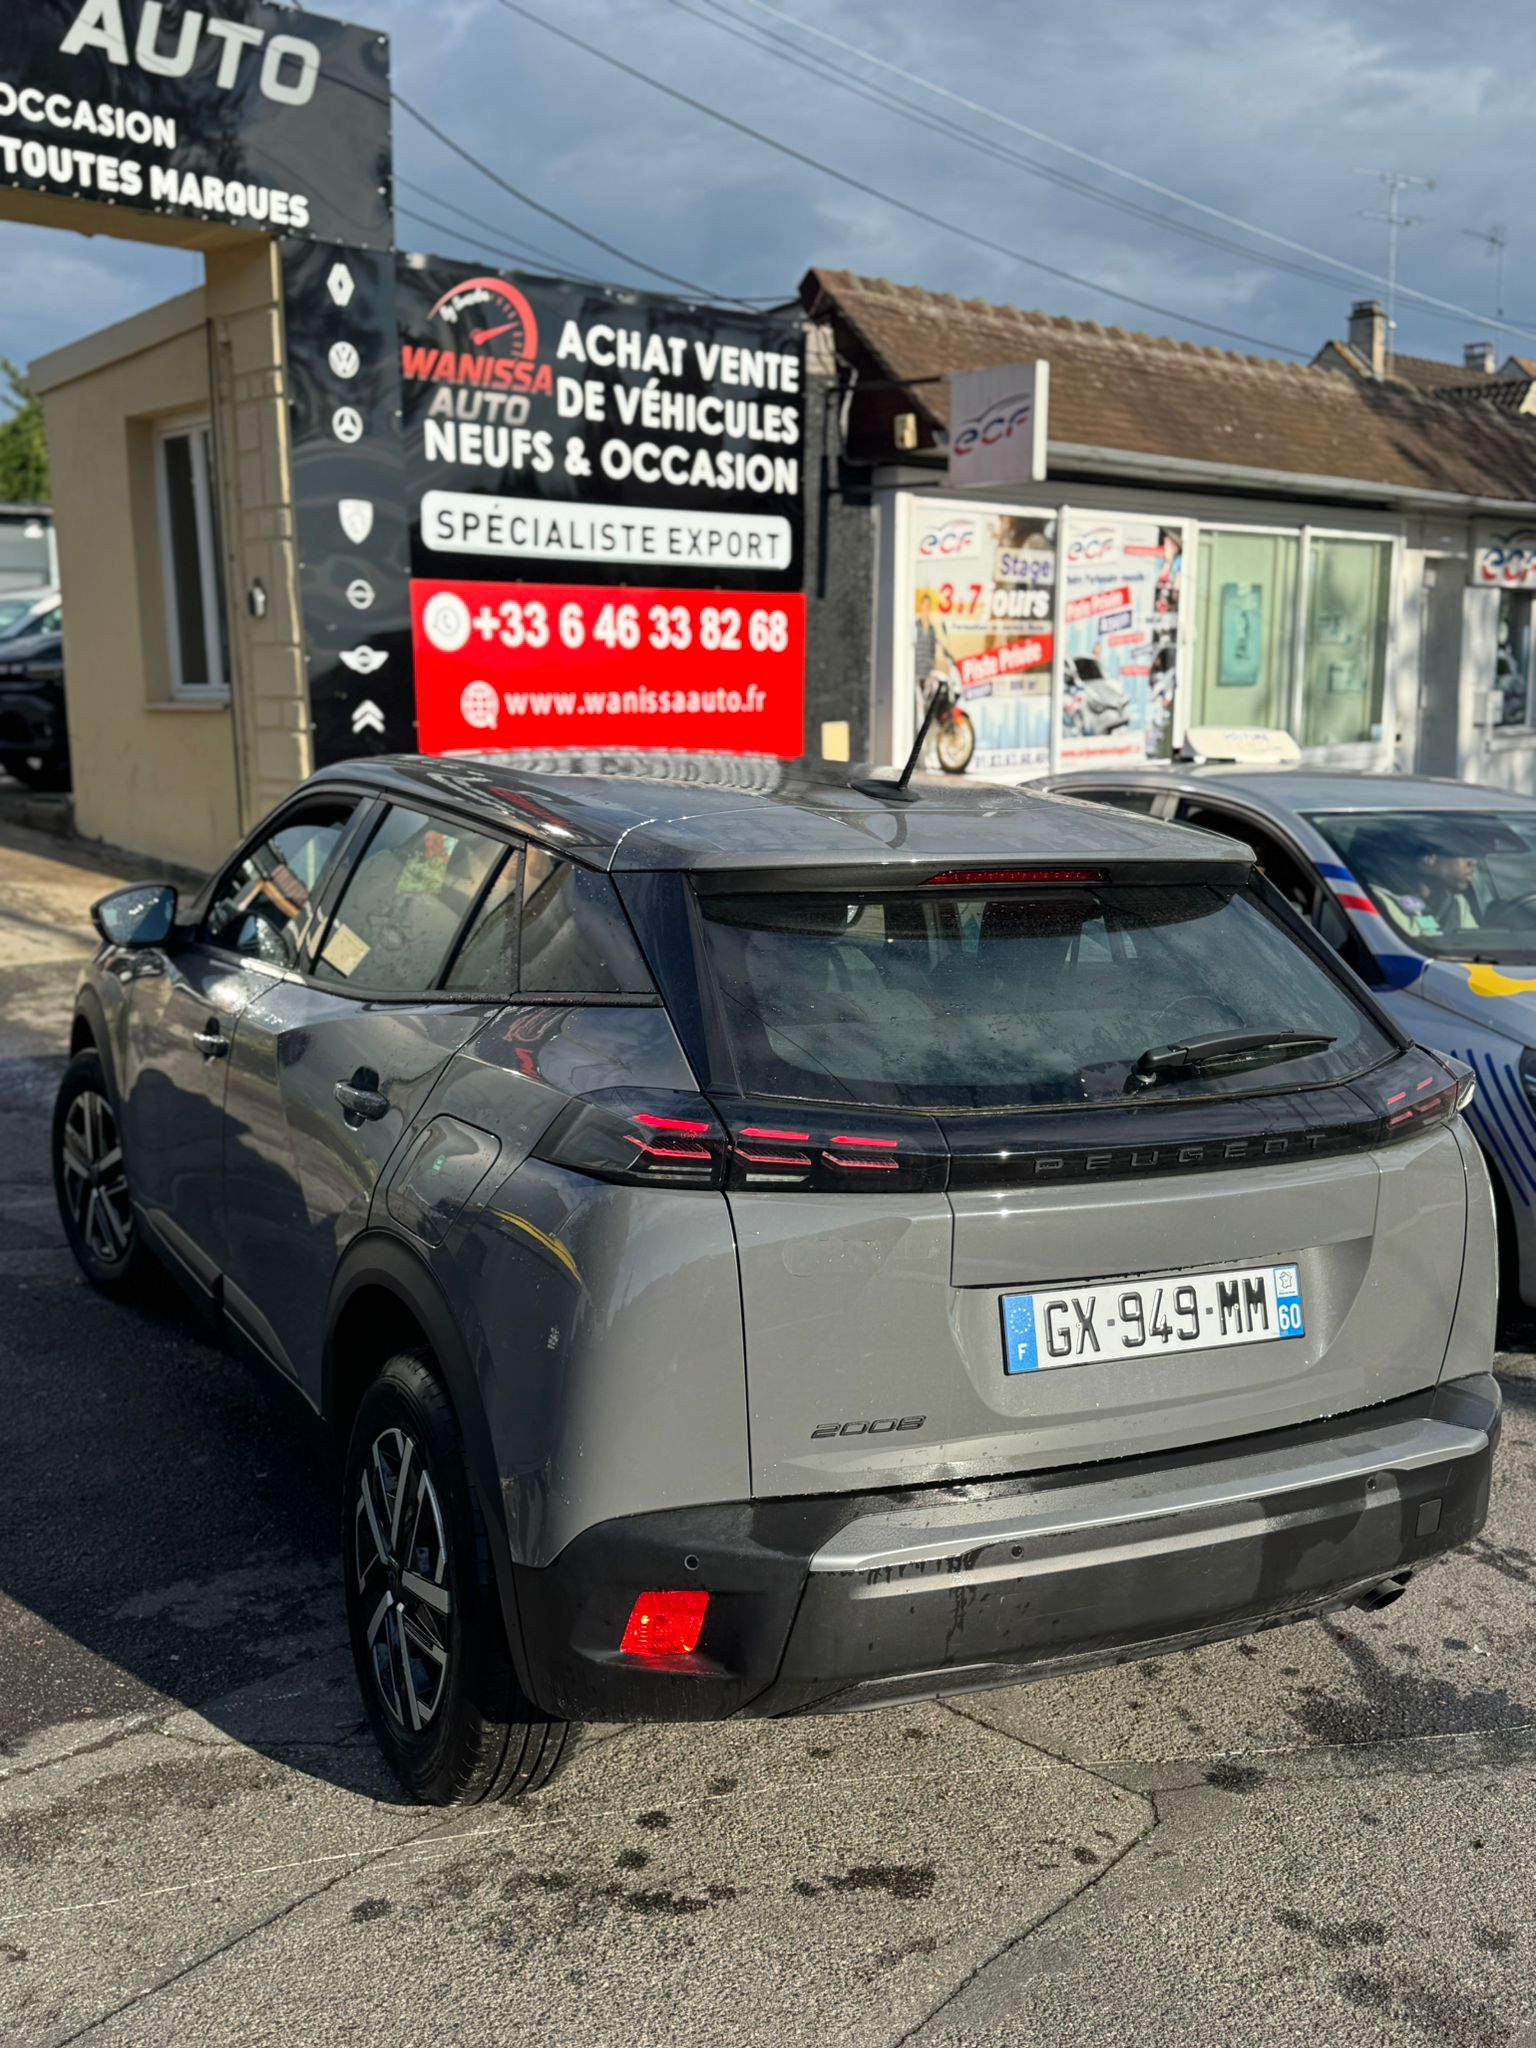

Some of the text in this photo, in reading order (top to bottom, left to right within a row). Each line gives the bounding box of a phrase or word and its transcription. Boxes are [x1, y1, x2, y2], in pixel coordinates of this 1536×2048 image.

[59, 0, 321, 106] AUTO
[0, 82, 176, 149] OCCASION
[0, 135, 309, 228] TOUTES MARQUES
[401, 345, 553, 395] WANISSA
[556, 320, 800, 394] ACHAT VENTE
[427, 387, 531, 426] AUTO
[556, 376, 800, 445] DE VÉHICULES
[423, 419, 799, 496] NEUFS & OCCASION
[436, 503, 780, 561] SPÉCIALISTE EXPORT
[1001, 553, 1051, 584] Stage
[473, 600, 789, 652] +33 6 46 33 82 68
[504, 684, 766, 716] www.wanissaauto.fr
[1034, 1133, 1326, 1174] PEUGEOT
[1043, 1276, 1269, 1358] GX-949-MM
[1278, 1303, 1301, 1331] 60
[1017, 1343, 1028, 1360] F
[811, 1415, 927, 1440] 2008
